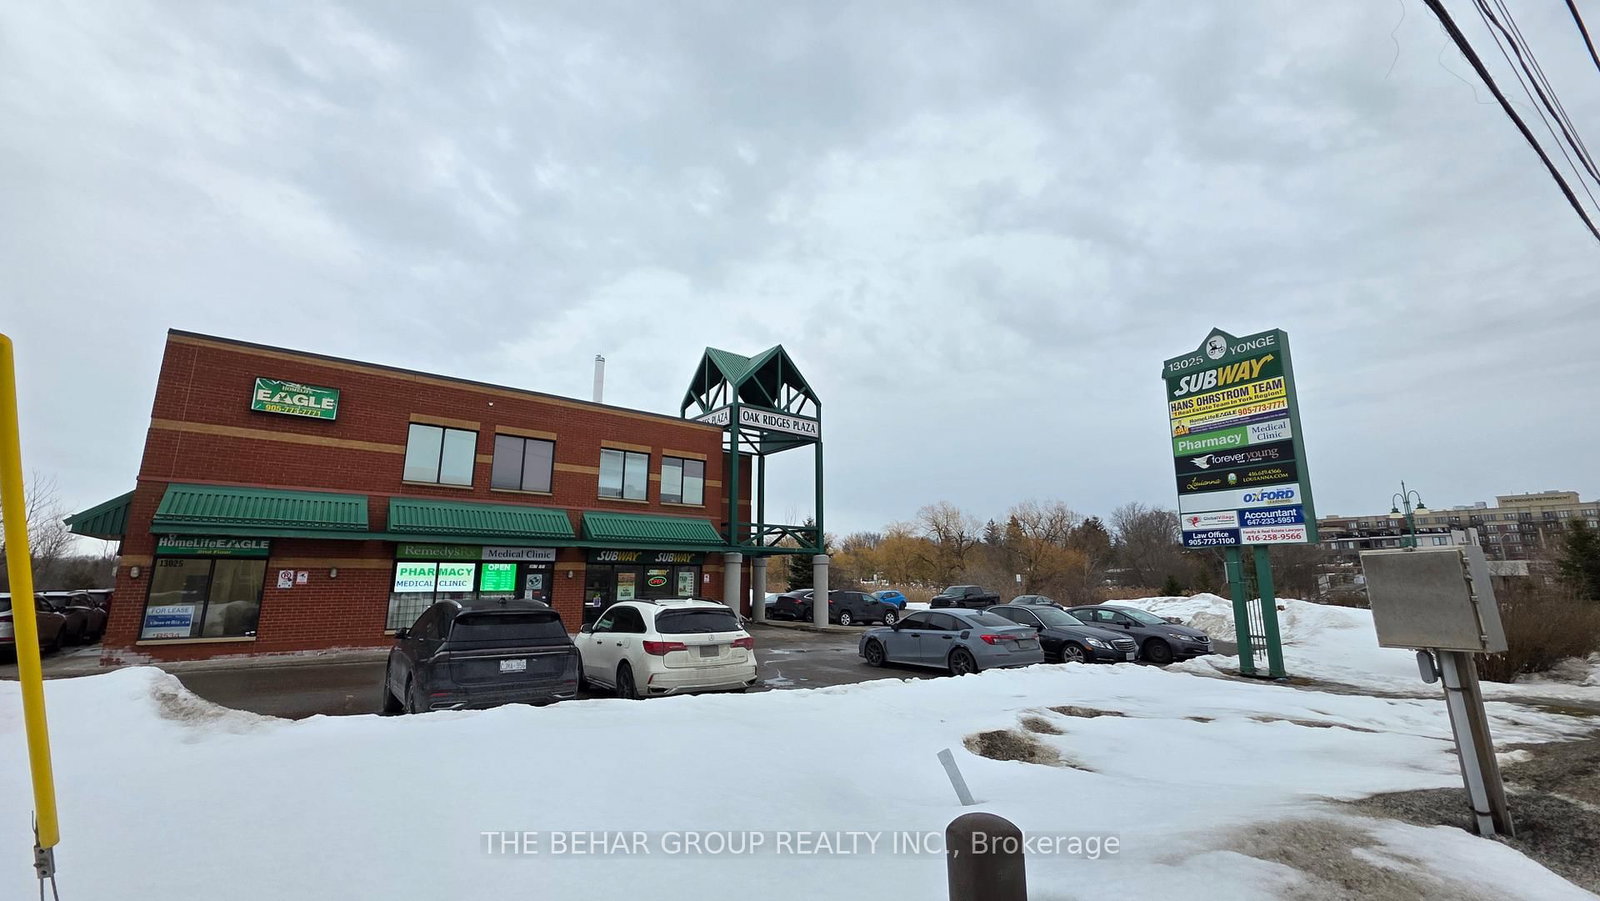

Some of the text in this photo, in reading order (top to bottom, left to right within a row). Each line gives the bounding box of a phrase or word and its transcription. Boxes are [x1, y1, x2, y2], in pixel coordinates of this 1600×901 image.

[1229, 334, 1276, 355] YONGE
[1168, 355, 1204, 372] 13025
[1174, 353, 1275, 397] SUBWAY
[256, 388, 336, 410] EAGLE
[1170, 378, 1283, 412] HANS OHRSTROM TEAM
[1192, 404, 1212, 413] Estate
[1212, 400, 1230, 410] Team
[1238, 396, 1253, 405] York
[1237, 400, 1286, 417] 905-773-7771
[265, 404, 321, 417] 905-773-7771
[743, 410, 816, 434] OAK RIDGES PLAZA
[1252, 421, 1287, 434] Medical
[1178, 432, 1242, 451] Pharmacy
[1257, 431, 1283, 442] Clinic
[1243, 489, 1295, 503] OXFORD
[1244, 508, 1298, 519] Accountant
[1246, 516, 1295, 526] 647-233-5951
[1207, 531, 1229, 539] Office
[1246, 532, 1302, 542] 416-258-9566
[1188, 537, 1236, 546] 905-773-1100
[488, 549, 551, 560] Medical Clinic
[597, 551, 641, 562] SUBWAY
[655, 552, 695, 563] SUBWAY
[159, 559, 184, 568] 13025
[487, 563, 511, 571] OPEN
[400, 567, 474, 576] PHARMACY
[396, 580, 468, 588] MEDICAL CLINIC
[151, 606, 190, 615] FOR LEASE
